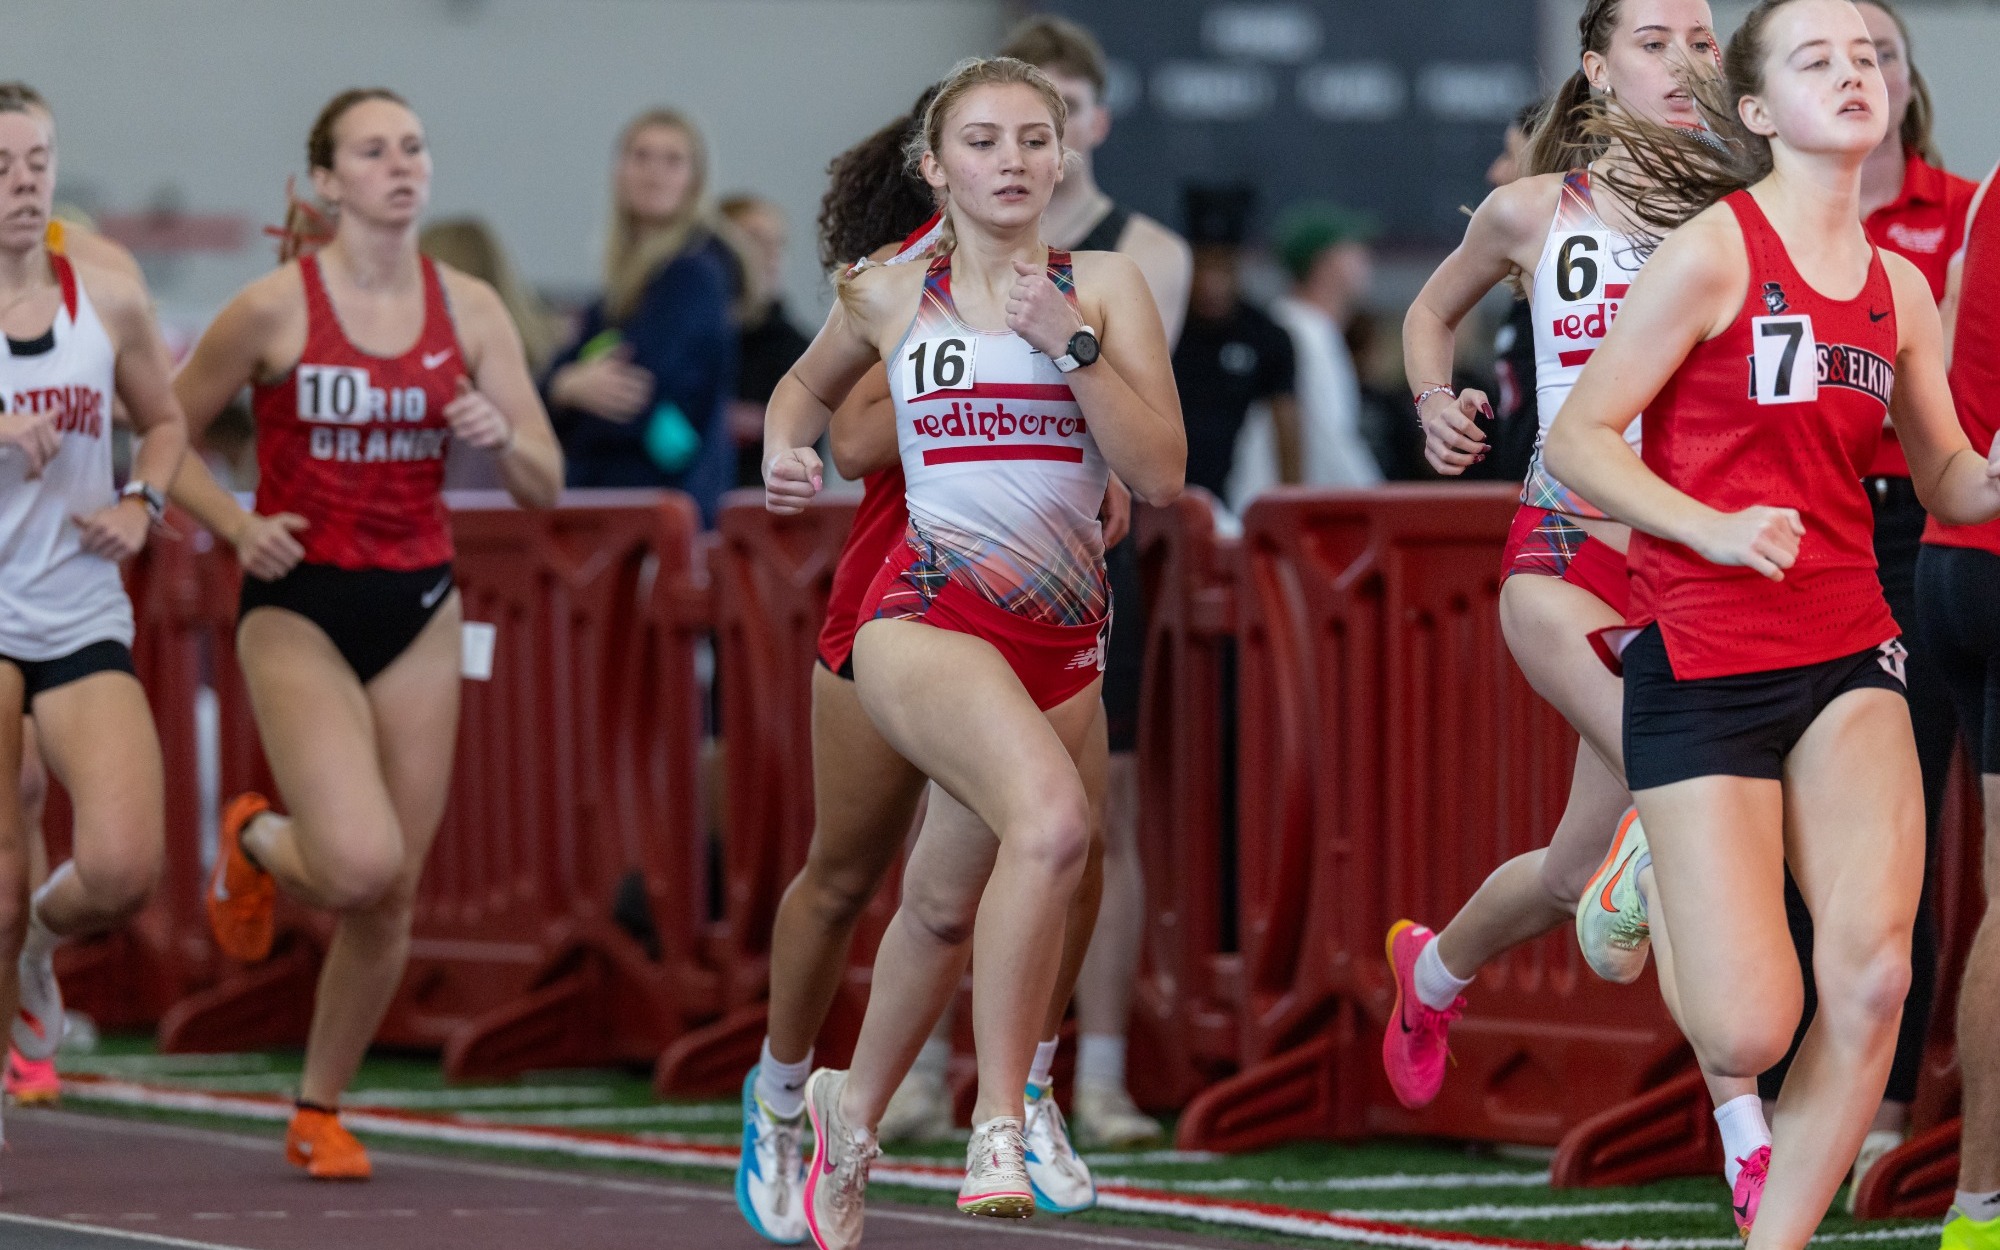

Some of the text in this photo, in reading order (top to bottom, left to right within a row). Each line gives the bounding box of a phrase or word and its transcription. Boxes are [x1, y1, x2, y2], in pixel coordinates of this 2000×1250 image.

[1557, 235, 1598, 301] 6
[908, 338, 967, 395] 16
[1761, 322, 1803, 396] 7
[304, 373, 357, 416] 10
[368, 386, 427, 422] RIO
[922, 402, 1076, 442] edinboro
